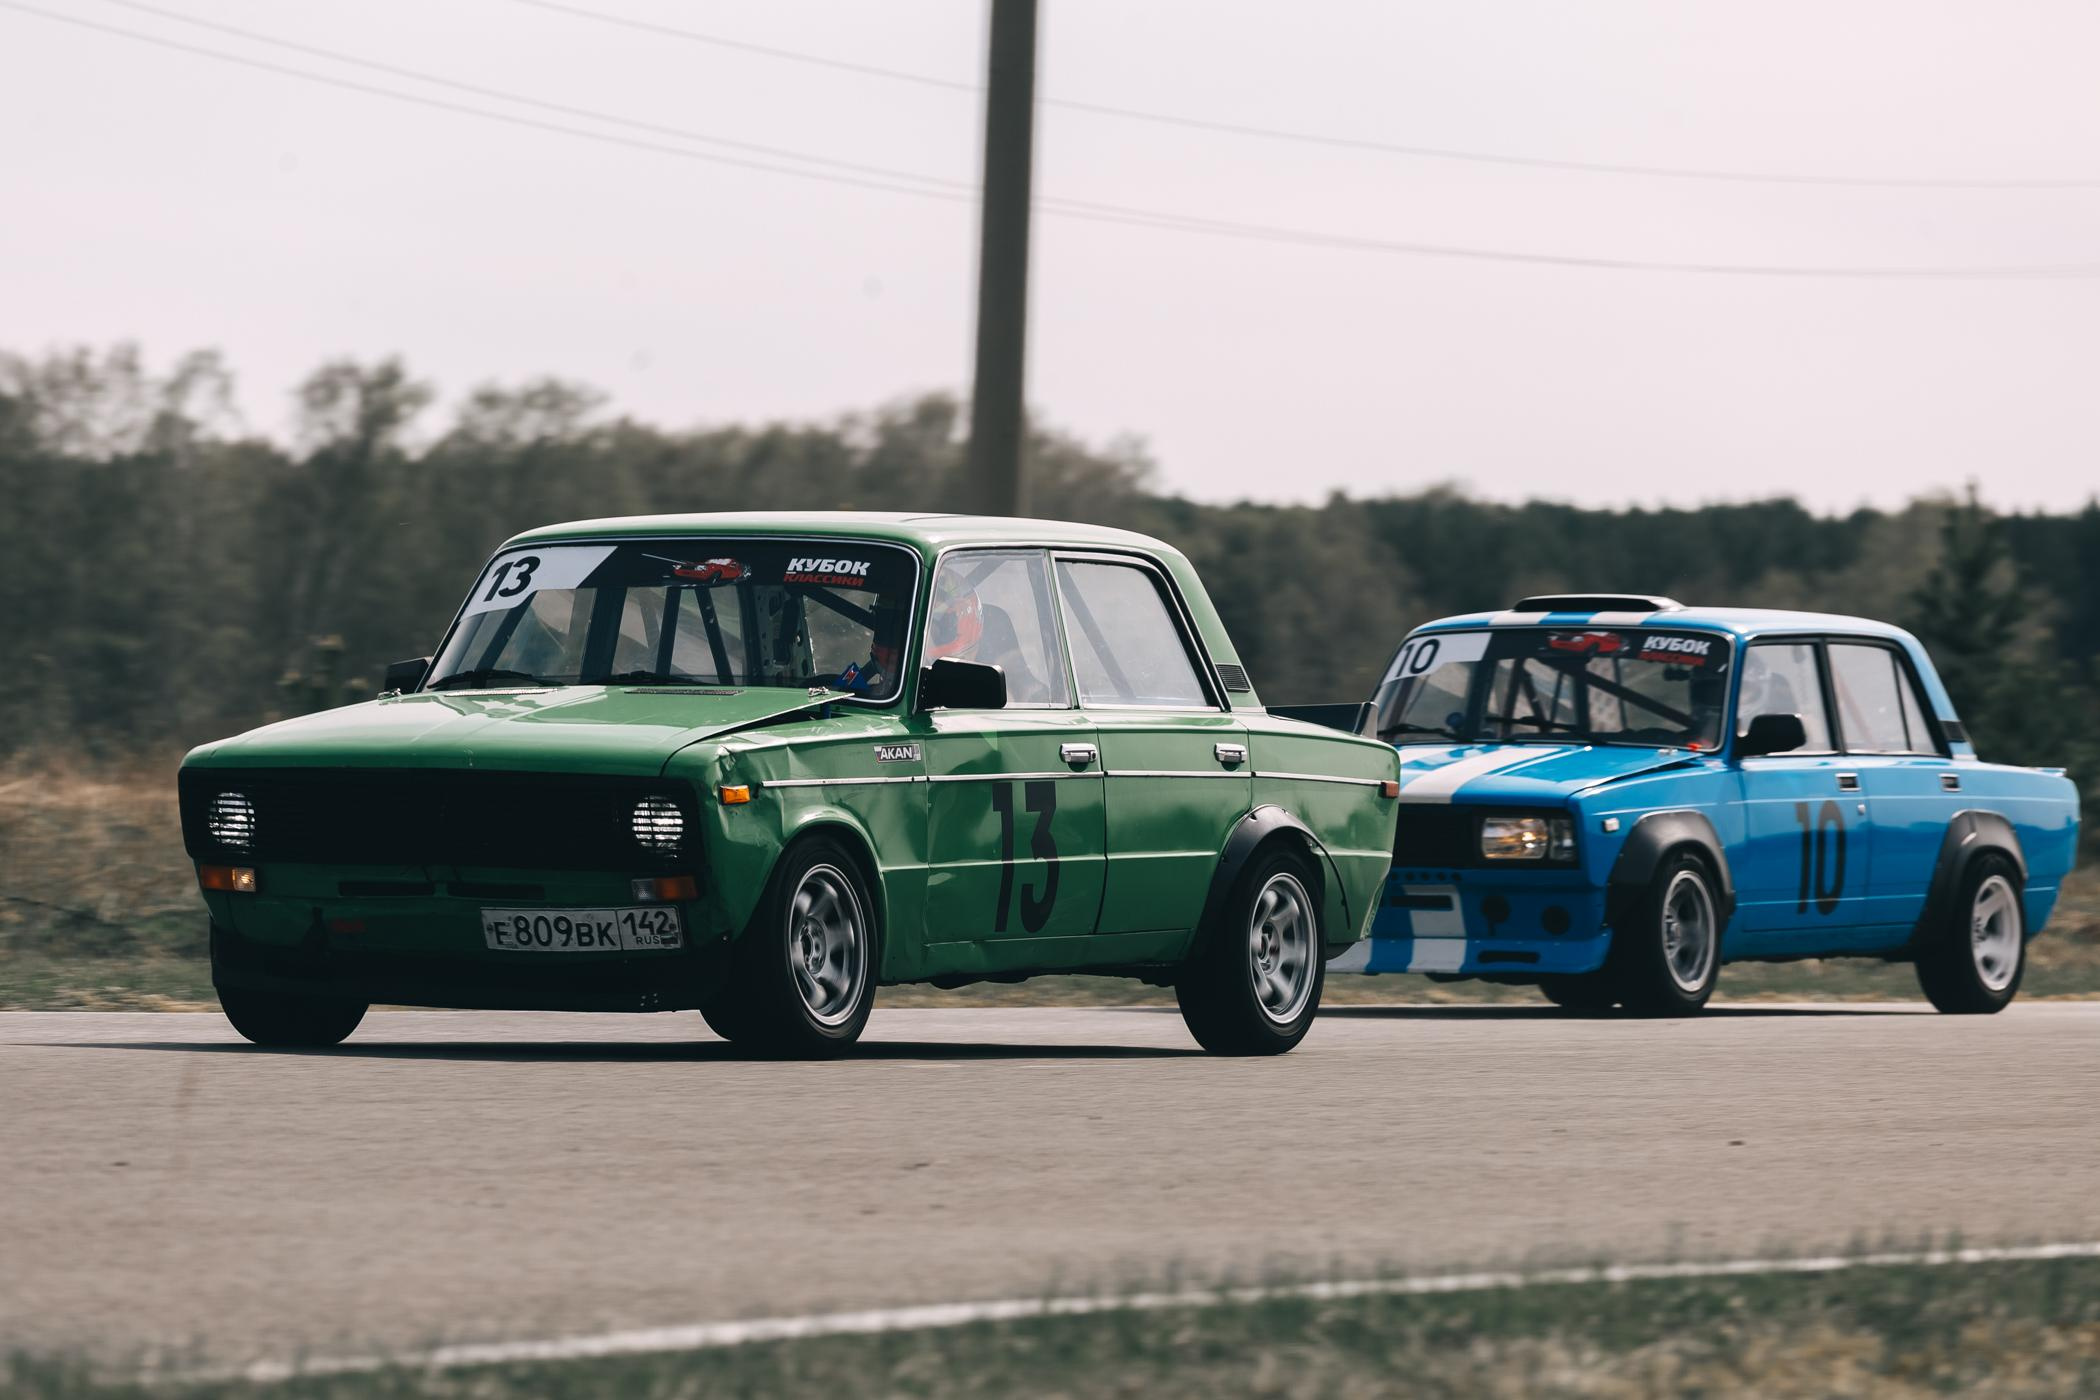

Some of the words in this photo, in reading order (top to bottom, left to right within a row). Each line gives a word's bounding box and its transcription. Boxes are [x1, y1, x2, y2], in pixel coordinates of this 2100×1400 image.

[483, 556, 541, 602] 13
[787, 558, 871, 576] КУБОК
[1395, 638, 1440, 677] 10
[1643, 636, 1711, 655] КУБОК
[881, 746, 913, 760] AKAN
[992, 781, 1060, 933] 13
[1795, 800, 1846, 915] 10
[622, 911, 670, 936] 142
[636, 936, 660, 945] RUS
